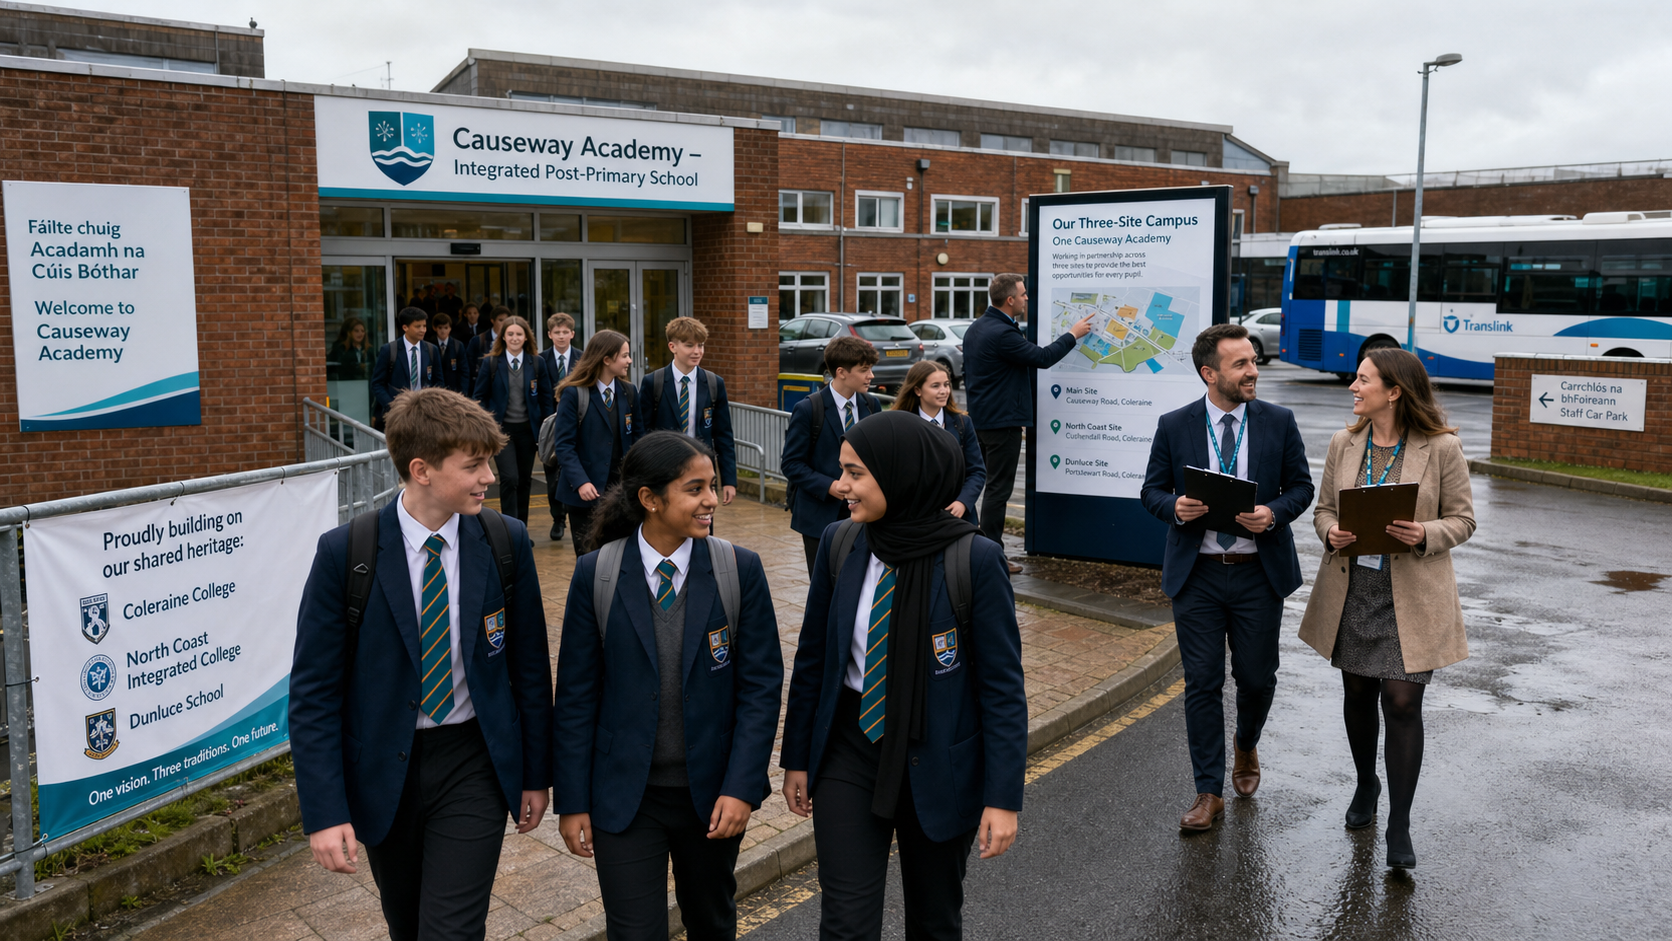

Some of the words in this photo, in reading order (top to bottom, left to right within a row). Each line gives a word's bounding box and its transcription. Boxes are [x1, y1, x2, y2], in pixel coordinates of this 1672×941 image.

[453, 126, 574, 161] Causeway
[580, 136, 684, 167] Academy
[454, 159, 540, 181] Integrated
[545, 164, 646, 188] Post-Primary
[649, 170, 698, 187] School
[28, 219, 73, 235] Fáilte
[77, 220, 121, 240] chuig
[1052, 218, 1076, 230] Our
[1078, 215, 1142, 229] Three-Site
[1145, 214, 1198, 229] Campus
[1052, 236, 1072, 246] One
[1074, 235, 1123, 246] Causeway
[1124, 233, 1172, 245] Academy
[30, 241, 118, 258] Acadamh
[123, 246, 145, 259] na
[1052, 252, 1079, 261] Working
[31, 262, 73, 280] Cúis
[77, 262, 139, 280] Bóthar
[1093, 262, 1119, 270] provide
[1051, 272, 1094, 281] opportunities
[1094, 271, 1105, 279] for
[1105, 272, 1124, 280] every
[34, 300, 114, 316] Welcome
[117, 301, 135, 315] to
[36, 323, 130, 342] Causeway
[1463, 318, 1514, 333] Translink
[38, 344, 123, 364] Academy
[1065, 386, 1083, 395] Main
[1084, 387, 1098, 395] Site
[1560, 381, 1607, 393] Carrchlós
[1610, 385, 1622, 393] na
[1100, 397, 1120, 406] Road,
[1120, 398, 1153, 407] Coleraine
[1561, 394, 1616, 405] bhFoireann
[1560, 408, 1583, 418] Staff
[1586, 409, 1603, 420] Car
[1606, 411, 1628, 421] Park
[1065, 422, 1086, 431] North
[1086, 423, 1107, 431] Coast
[1108, 423, 1122, 432] Site
[1121, 434, 1152, 443] Coleraine
[1065, 458, 1093, 467] Dunluce
[1094, 459, 1109, 468] Site
[103, 523, 165, 551] Proudly
[168, 512, 224, 538] building
[226, 511, 243, 525] on
[102, 559, 130, 579] our
[133, 544, 184, 572] shared
[187, 535, 244, 560] heritage:
[123, 593, 190, 620] Coleraine
[192, 581, 236, 602] College
[126, 642, 170, 668] North
[172, 631, 209, 654] Coast
[127, 654, 198, 690] Integrated
[200, 644, 242, 668] College
[129, 704, 184, 730] Dunluce
[186, 683, 223, 710] School
[88, 790, 114, 806] One
[115, 773, 151, 796] vision.
[152, 761, 182, 781] Three
[183, 743, 230, 769] traditions.
[231, 734, 250, 749] One
[250, 721, 279, 741] future.
